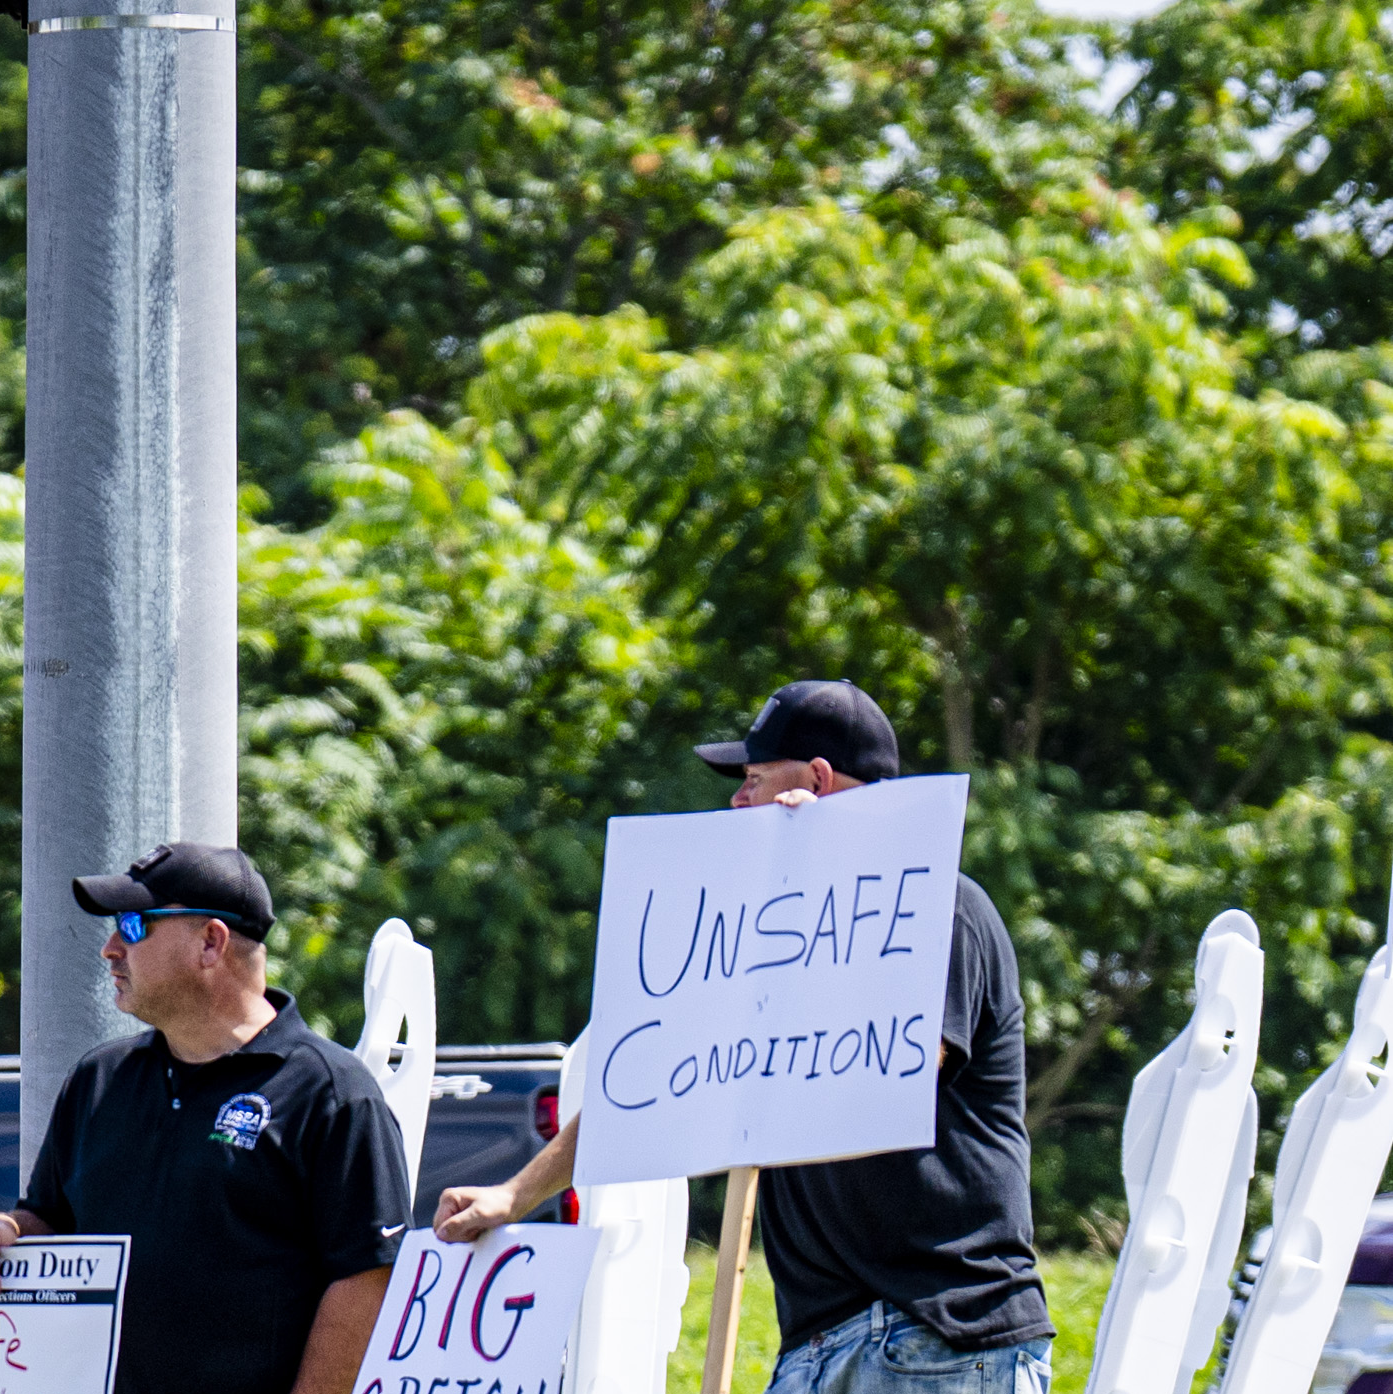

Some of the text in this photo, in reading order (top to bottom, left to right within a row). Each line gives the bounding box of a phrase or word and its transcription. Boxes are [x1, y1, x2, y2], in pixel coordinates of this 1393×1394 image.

[638, 867, 930, 997] UNSAFE
[602, 1013, 926, 1111] CONDITIONS
[36, 1289, 77, 1303] Officers
[39, 1251, 100, 1286] Duty
[388, 1244, 535, 1362] BIG
